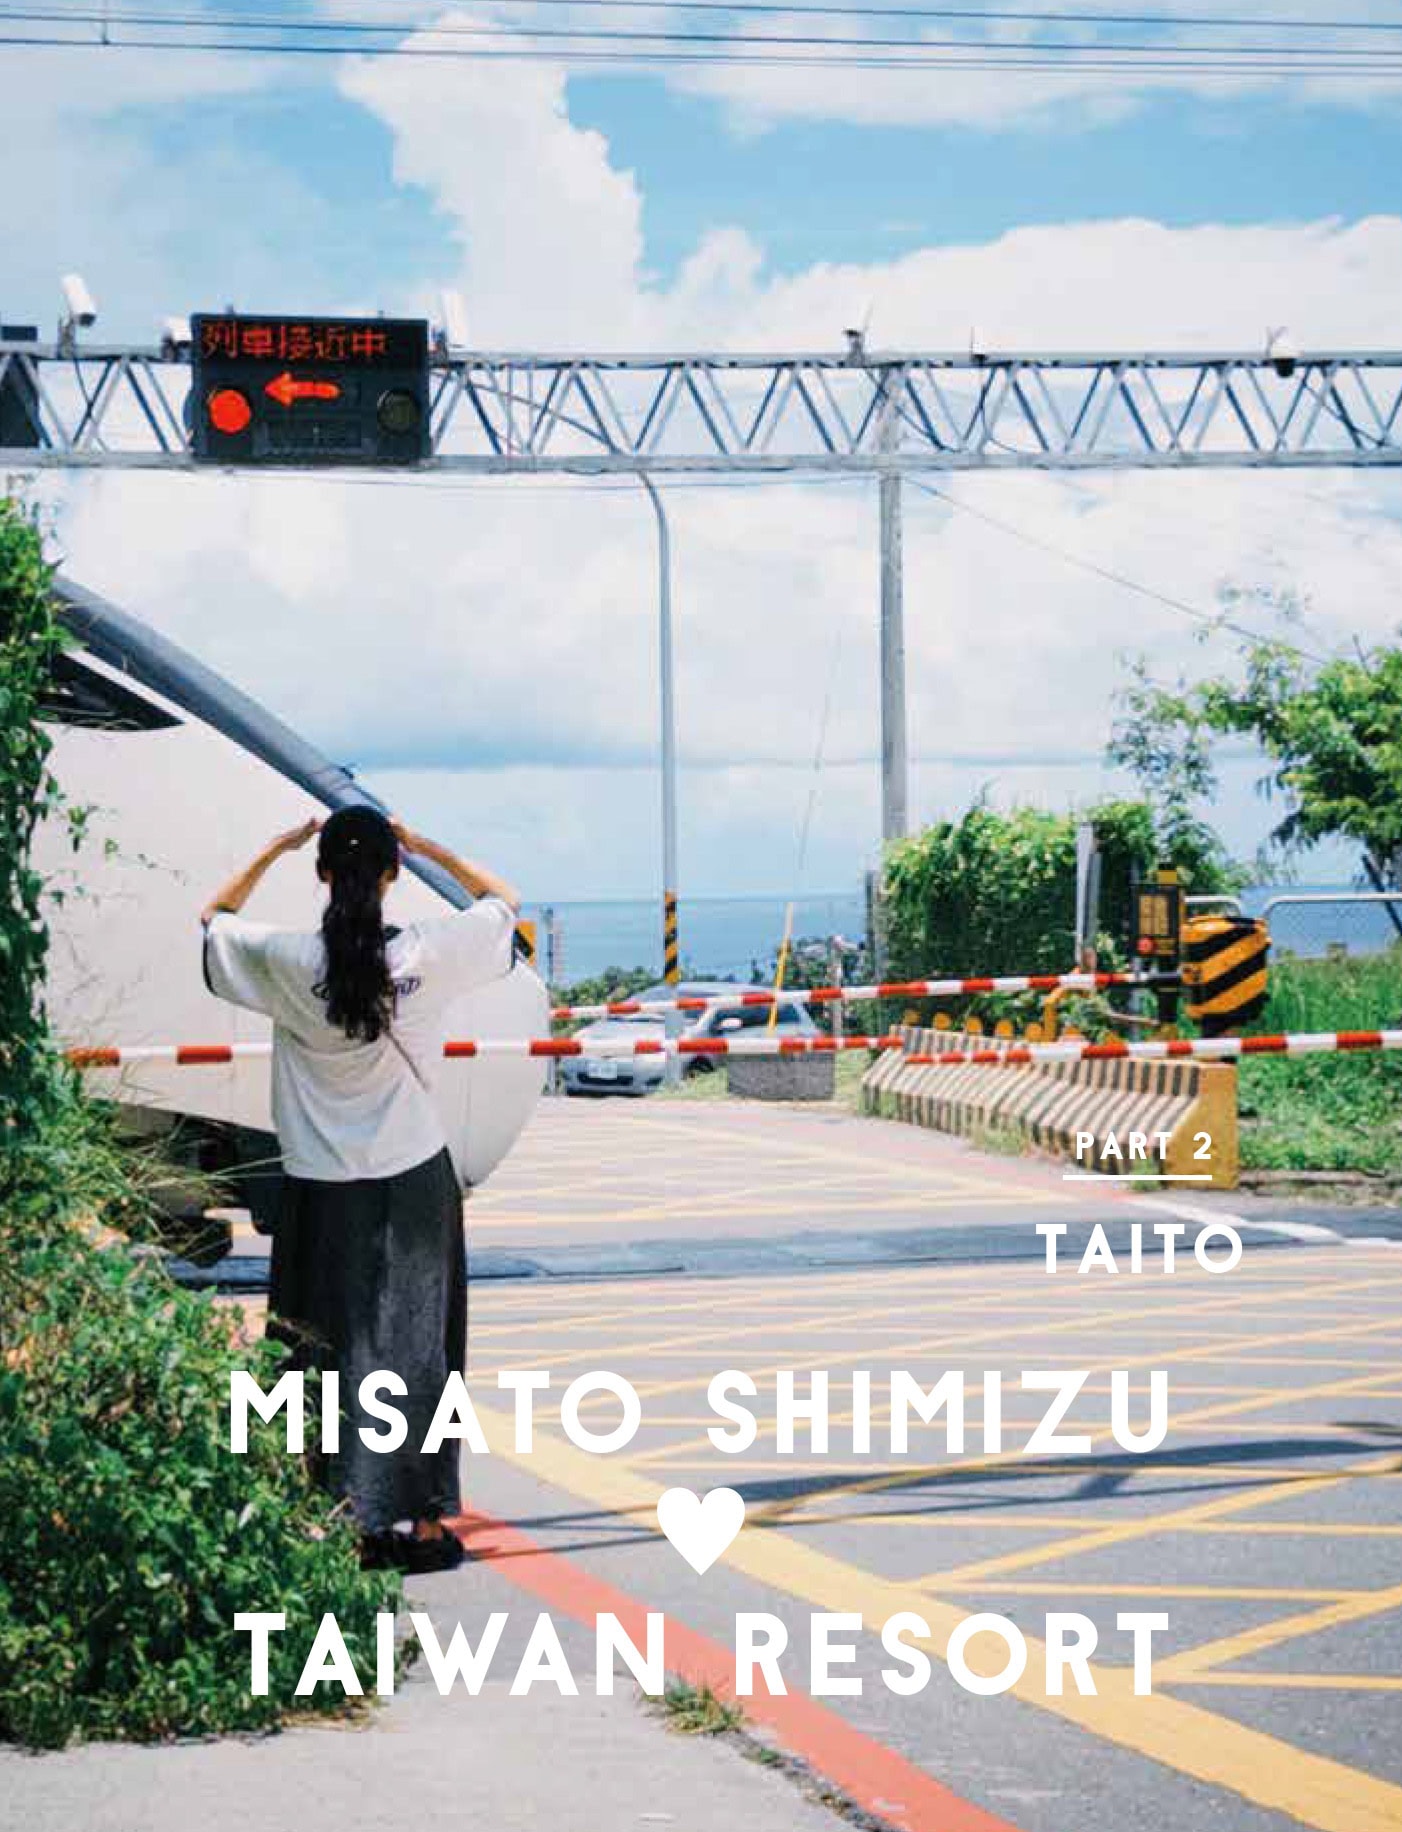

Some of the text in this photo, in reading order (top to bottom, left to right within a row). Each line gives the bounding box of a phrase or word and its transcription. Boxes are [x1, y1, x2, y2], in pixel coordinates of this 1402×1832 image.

[201, 320, 387, 360] 列車接近中
